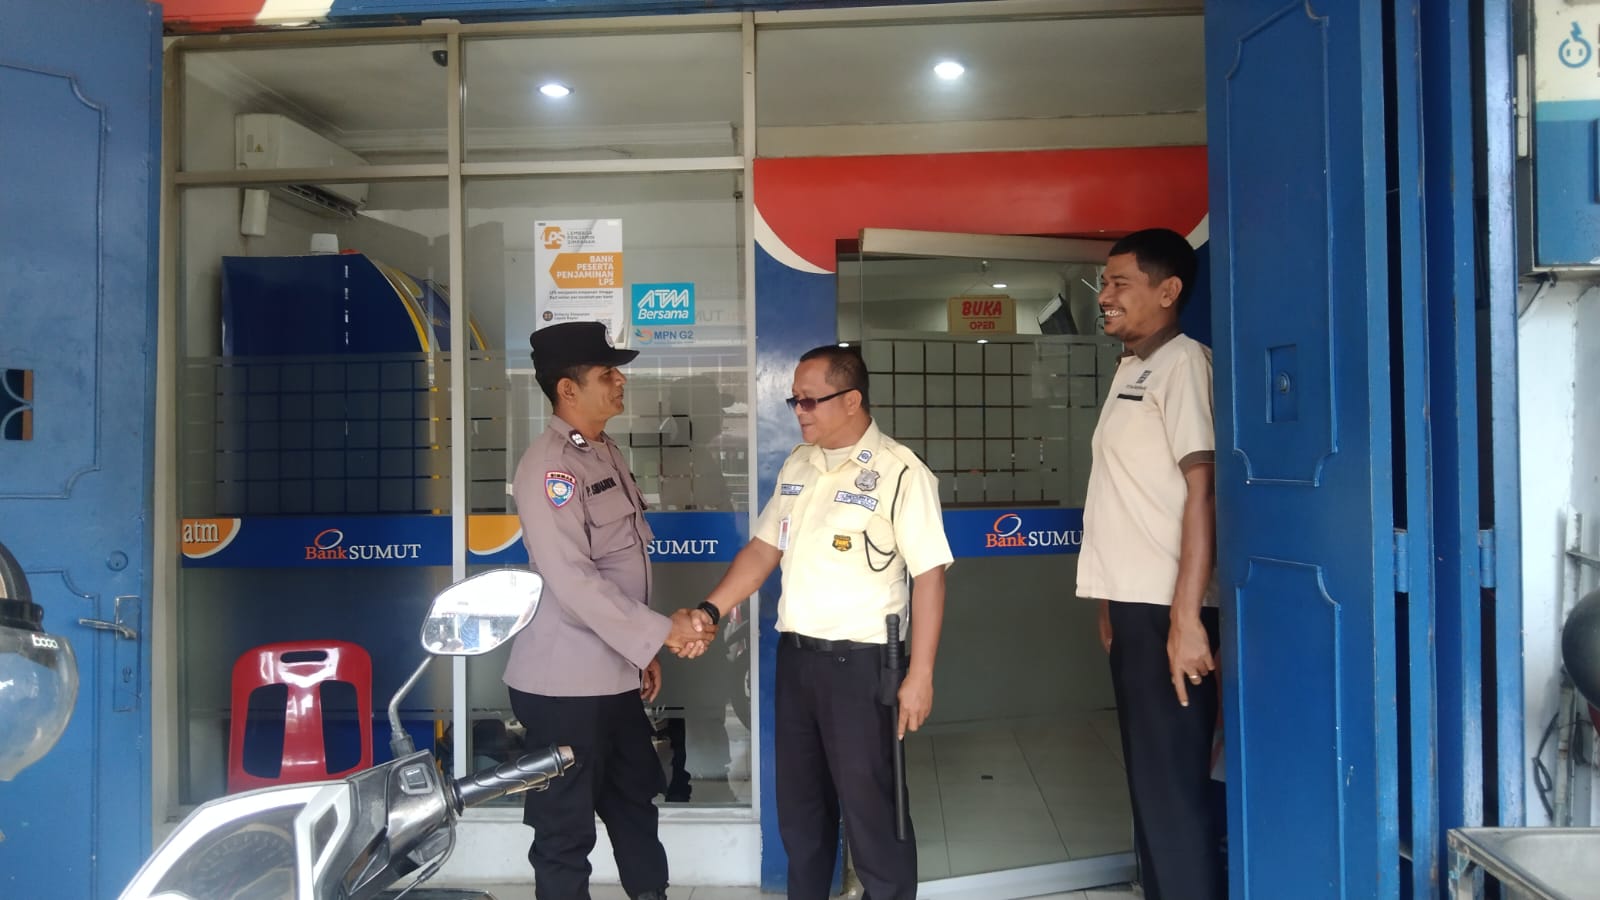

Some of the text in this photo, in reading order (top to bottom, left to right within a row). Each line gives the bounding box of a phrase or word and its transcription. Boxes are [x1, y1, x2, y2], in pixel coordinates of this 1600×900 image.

[589, 255, 614, 263] BANK
[557, 271, 614, 279] PENJAMINAN
[599, 278, 614, 286] LPS
[637, 289, 689, 308] ATM
[638, 308, 689, 320] Bersama
[961, 301, 1002, 317] BUKA
[969, 320, 996, 330] OPEN
[653, 330, 693, 340] MPN G2
[184, 521, 219, 543] atm
[646, 539, 719, 555] SUMUT
[985, 532, 1027, 548] Bank
[304, 543, 421, 560] Bank SUMUT
